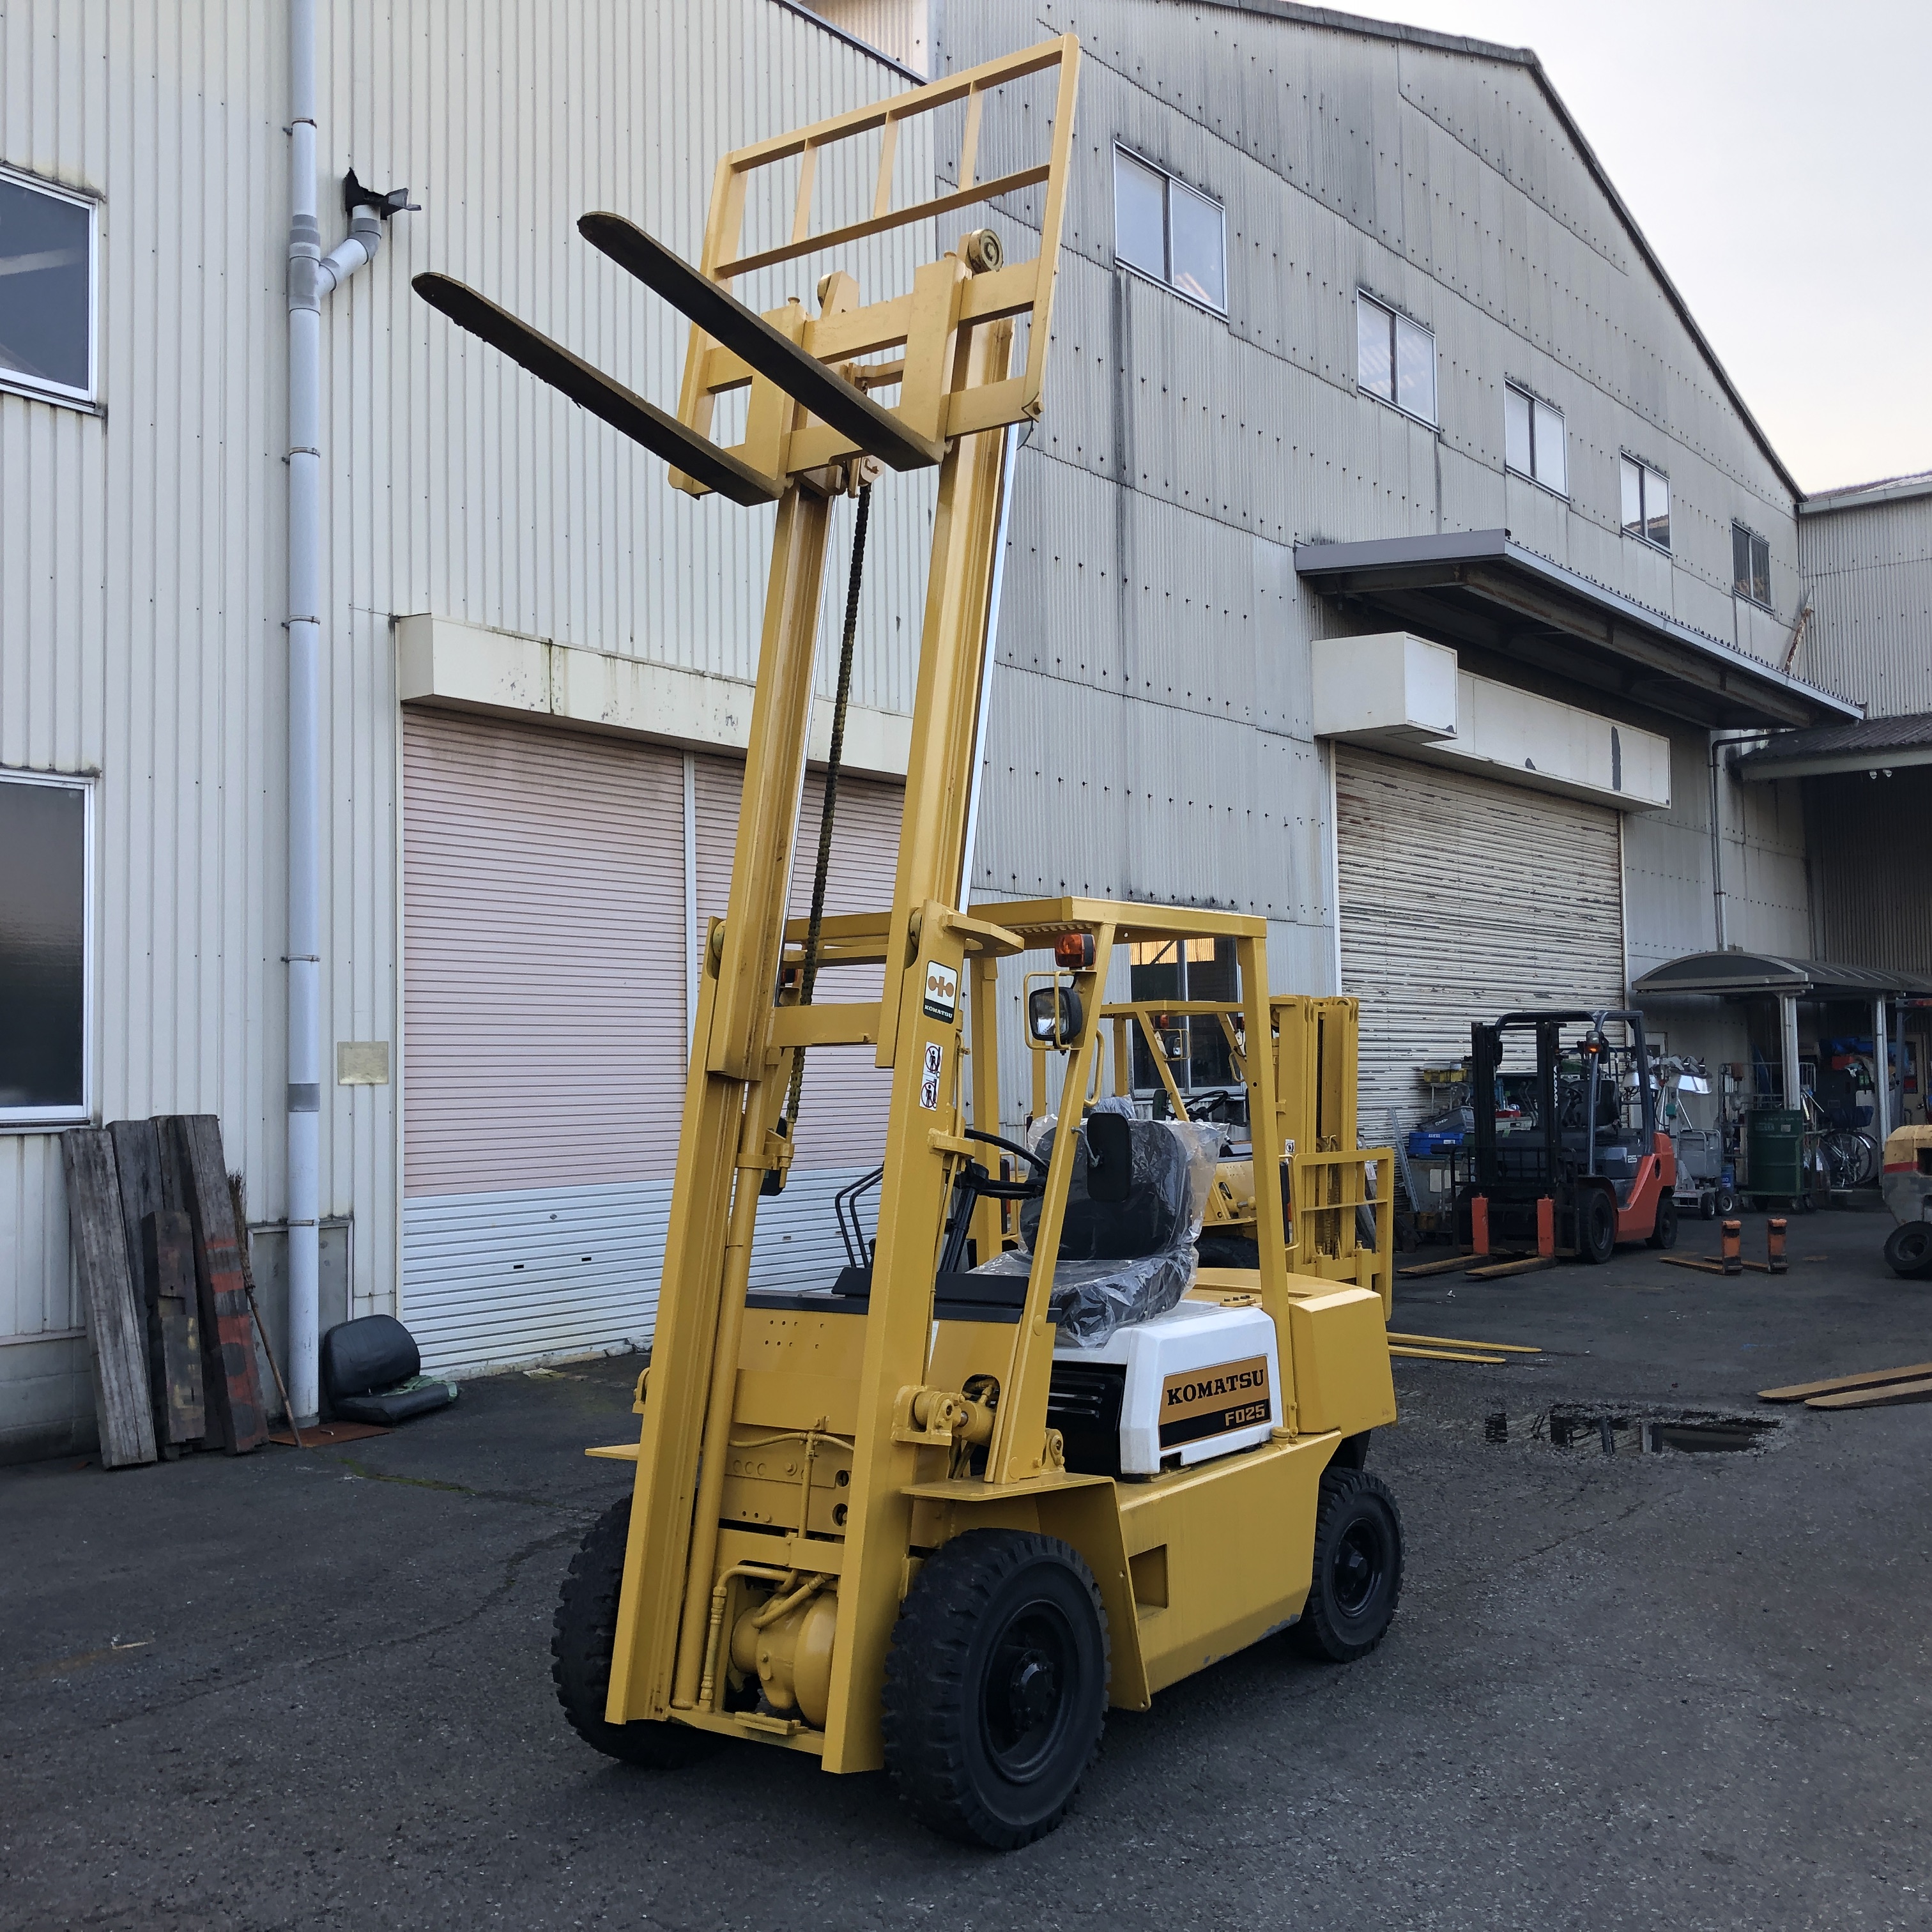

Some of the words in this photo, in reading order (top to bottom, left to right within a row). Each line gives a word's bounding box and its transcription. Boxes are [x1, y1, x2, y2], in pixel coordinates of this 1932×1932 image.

[924, 1004, 953, 1018] KOMATSU
[1627, 1154, 1637, 1163] 25
[1167, 1368, 1264, 1406] KOMATSU
